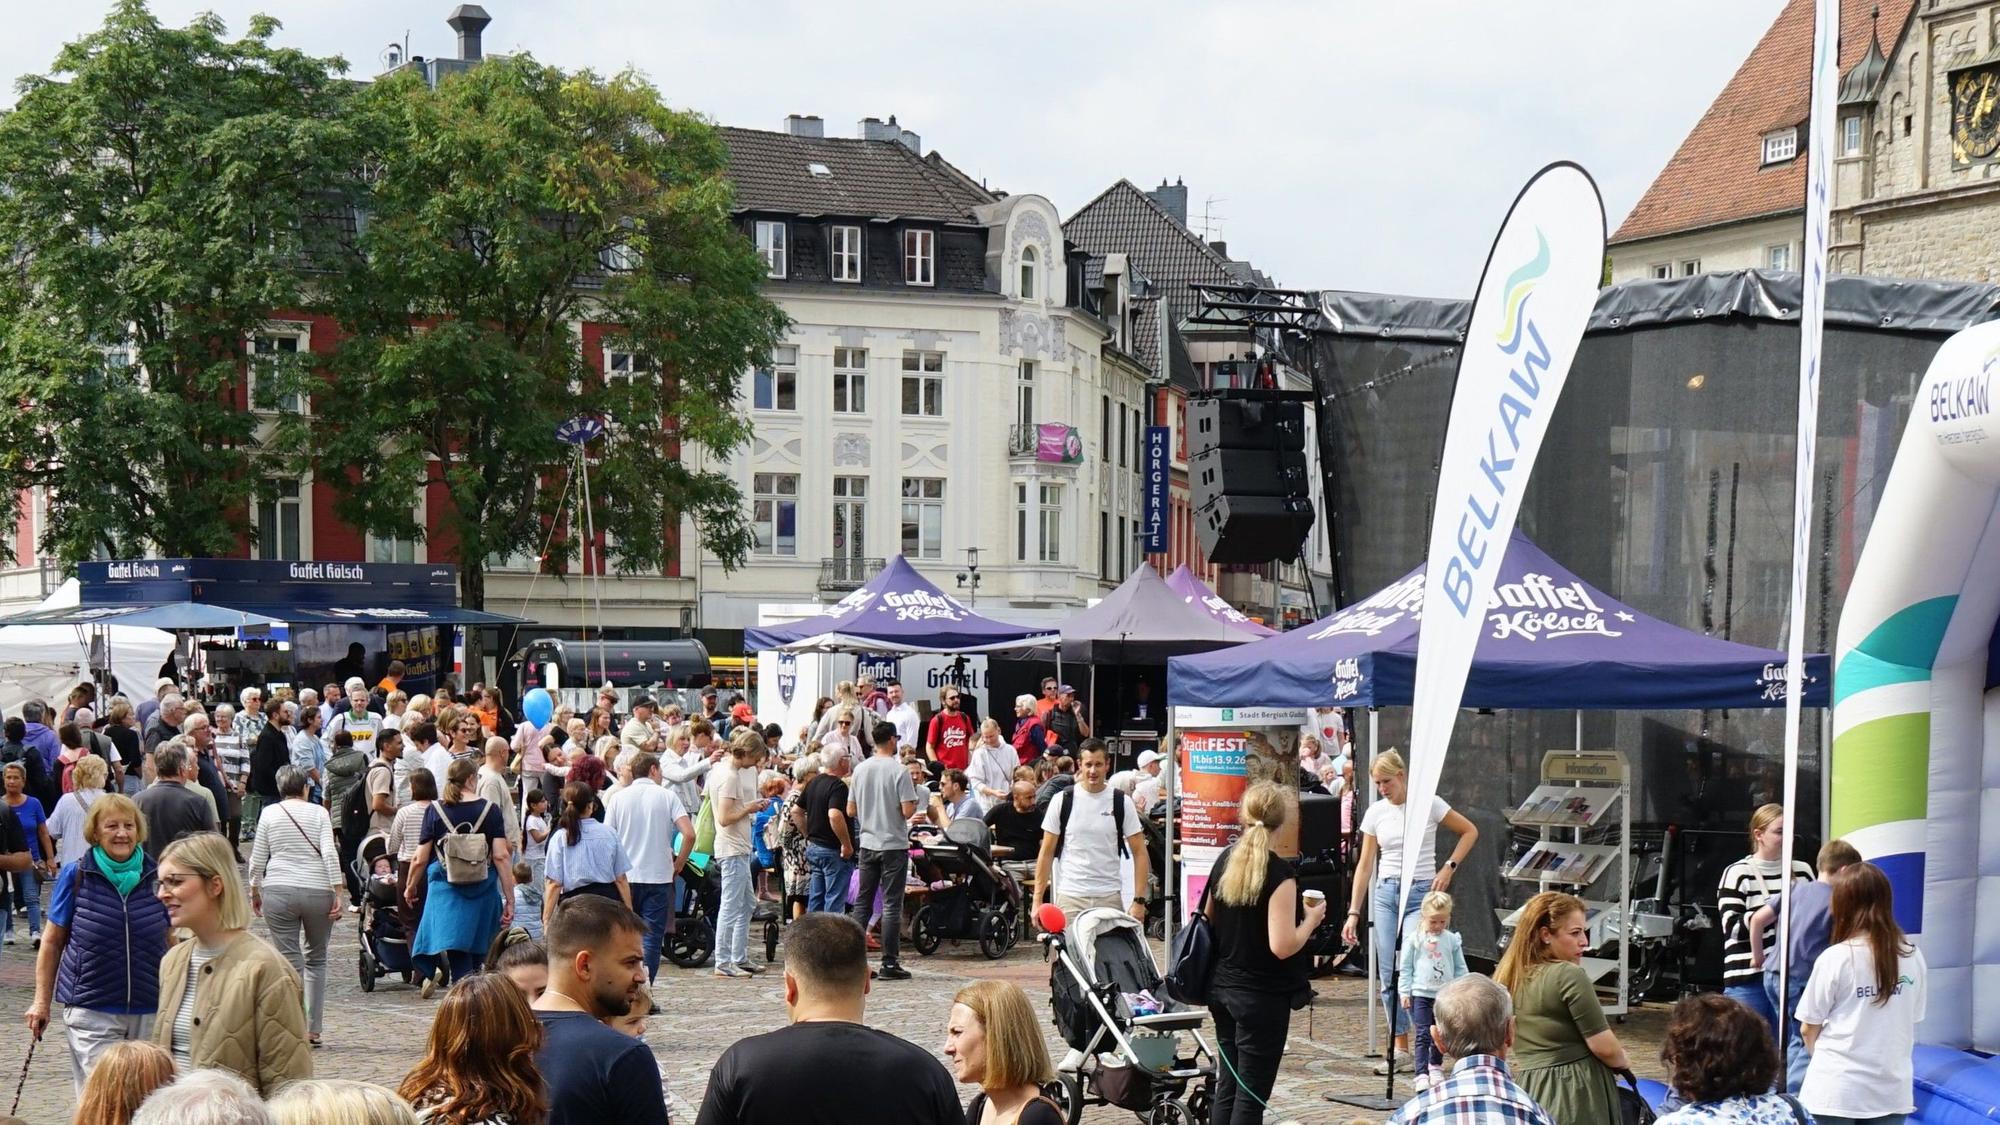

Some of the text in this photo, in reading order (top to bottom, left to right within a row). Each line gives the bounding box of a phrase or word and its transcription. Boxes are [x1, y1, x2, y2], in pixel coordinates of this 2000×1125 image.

[1930, 372, 1991, 423] BELKAW
[1442, 318, 1552, 619] BELKAW
[1151, 432, 1162, 547] HÖRGERÄTE
[108, 562, 132, 579] Gaffel
[290, 562, 363, 580] Gaffel Kölsch
[883, 589, 949, 609] Gaffel
[1486, 572, 1604, 614] affel
[895, 607, 963, 621] Kölsch
[1488, 609, 1623, 642] Kölsch
[858, 661, 896, 679] Gaffel
[1239, 711, 1260, 719] Stadt
[1261, 711, 1289, 720] Bergisch
[1565, 762, 1607, 776] Information
[1856, 984, 1904, 999] BELW
